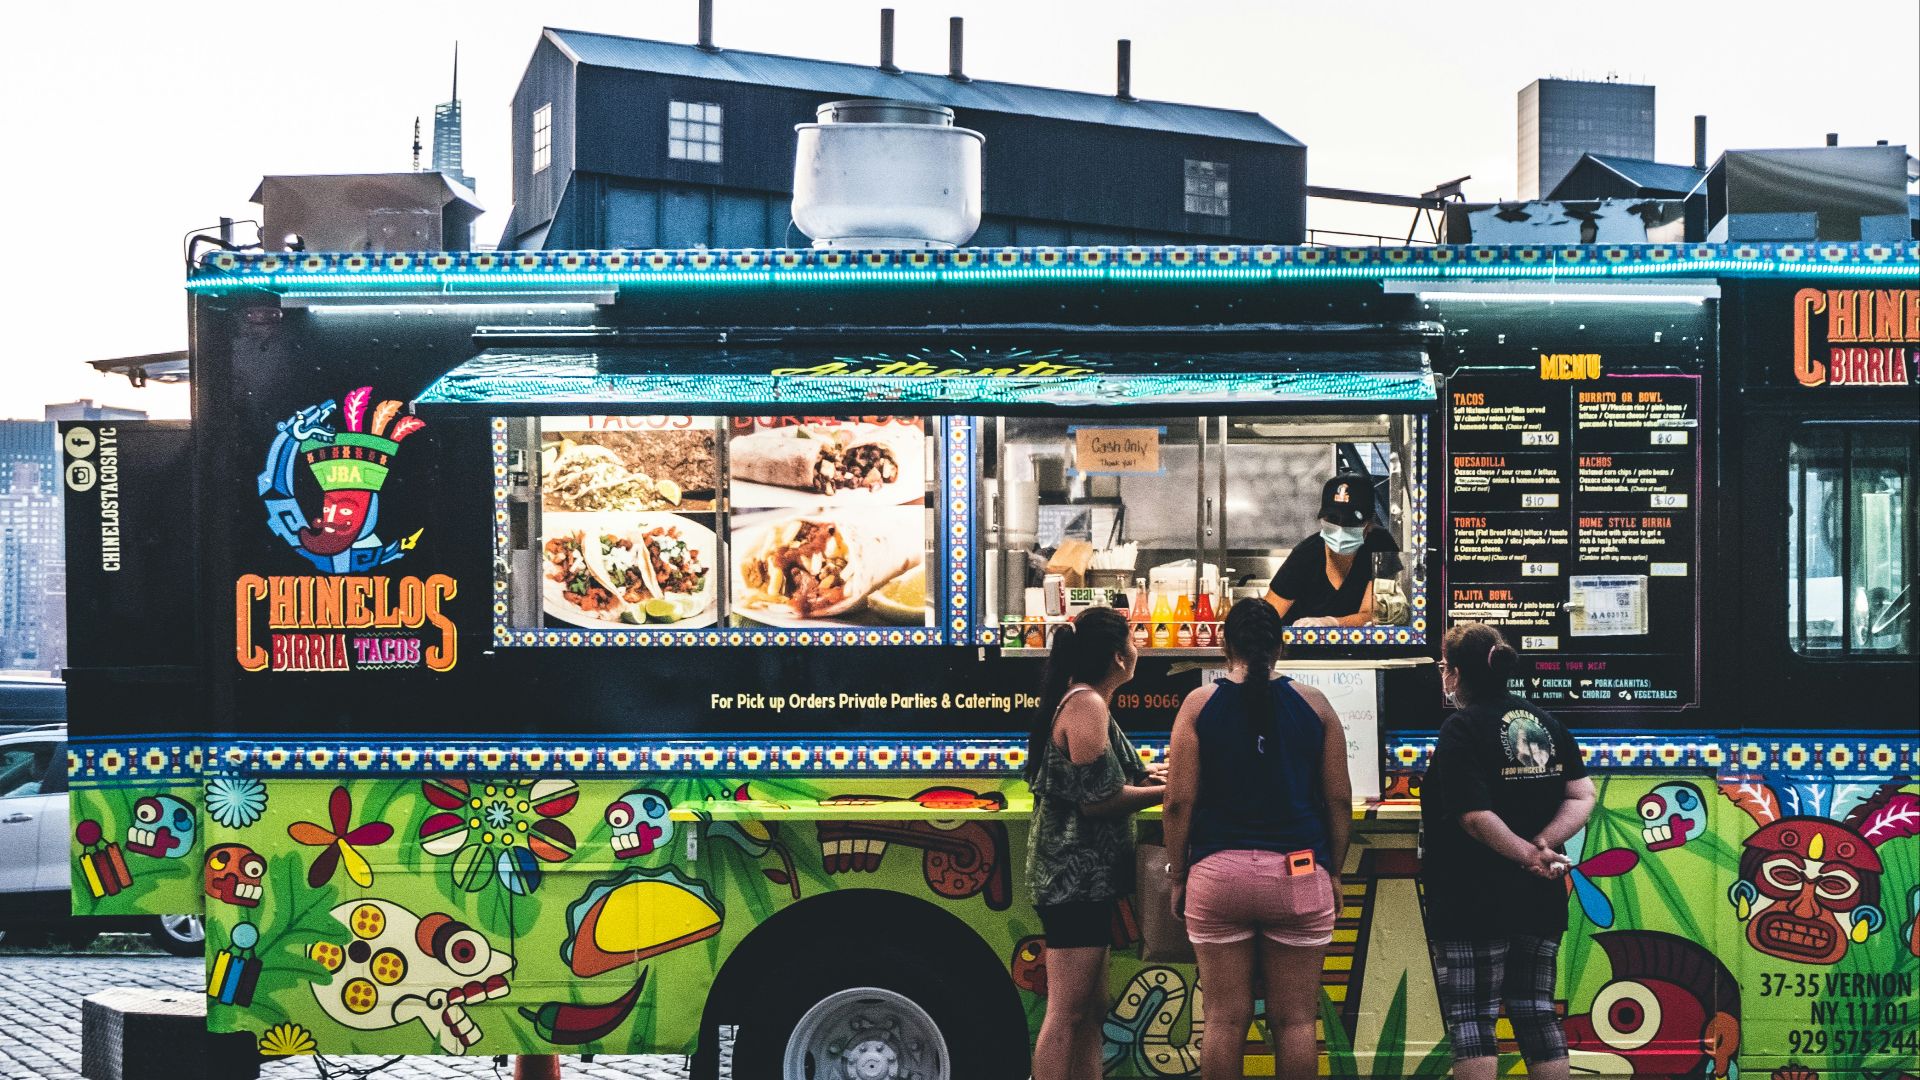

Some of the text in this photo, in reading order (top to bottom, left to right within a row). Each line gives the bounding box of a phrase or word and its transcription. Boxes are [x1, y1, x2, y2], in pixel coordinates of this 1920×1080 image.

[1541, 353, 1601, 380] MENU
[1830, 347, 1908, 385] BIRRIA
[1454, 393, 1485, 405] TACOS
[1579, 392, 1663, 402] BURRITO OR BOWL
[1491, 406, 1504, 414] corn
[1526, 406, 1545, 414] served
[1092, 437, 1147, 456] Cash Only
[1454, 457, 1505, 467] QUESADILLA
[1579, 457, 1612, 467] NACHOS
[327, 465, 362, 482] JBA
[100, 427, 120, 571] CHINELOSTACOSNYC
[1526, 496, 1544, 507] $10
[1654, 495, 1675, 507] $10
[1454, 517, 1486, 528] TORTAS
[1579, 517, 1672, 528] HOME STYLE BIRRIA
[1622, 529, 1639, 537] spices
[1454, 590, 1513, 600] FAJITA BOWL
[236, 573, 458, 672] CHINELOS
[1525, 637, 1544, 648] $12
[271, 633, 421, 672] BIRRIA TACOS
[1535, 662, 1606, 671] CHOOSE YOUR MEAT
[1507, 679, 1524, 688] TEAK
[1542, 679, 1572, 688] CHICKEN
[1582, 690, 1611, 699] CHORIZO
[1634, 690, 1677, 699] VEGETABLES
[711, 694, 733, 709] For
[737, 693, 765, 709] Pick
[769, 696, 785, 713] up
[789, 693, 835, 709] Orders
[839, 693, 887, 709] Private
[891, 693, 937, 709] Parties
[941, 693, 951, 709] &
[955, 693, 1011, 713] Catering
[1118, 694, 1180, 708] 819 9066
[1760, 973, 1912, 997] 37-35 VERNON
[1811, 1001, 1908, 1025] NY 11101
[1788, 1030, 1919, 1055] 929 575 244
